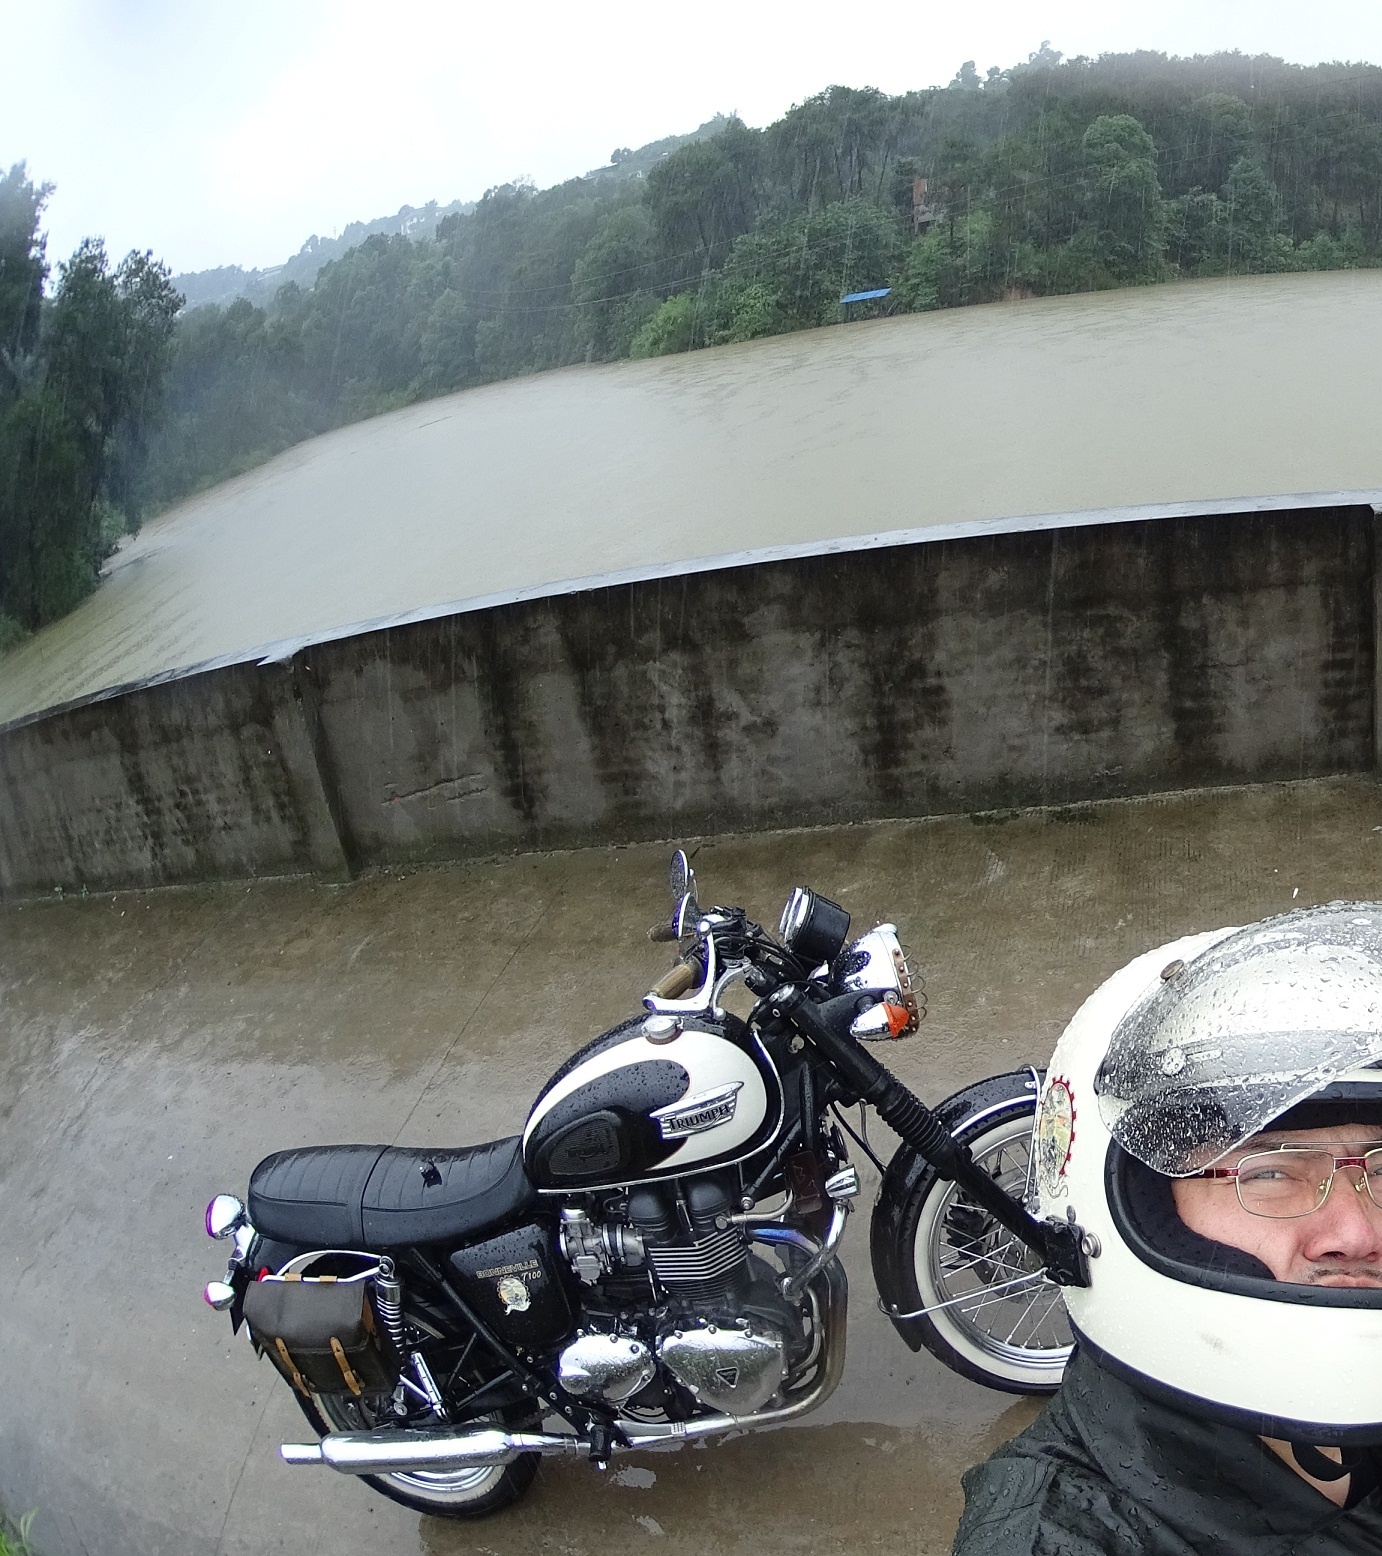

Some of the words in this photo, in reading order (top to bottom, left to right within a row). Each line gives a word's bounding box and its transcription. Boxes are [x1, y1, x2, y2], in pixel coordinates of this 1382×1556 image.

[666, 1104, 730, 1130] TRIUMPH
[475, 1259, 539, 1279] BONNEVILLE
[521, 1270, 542, 1282] T100
